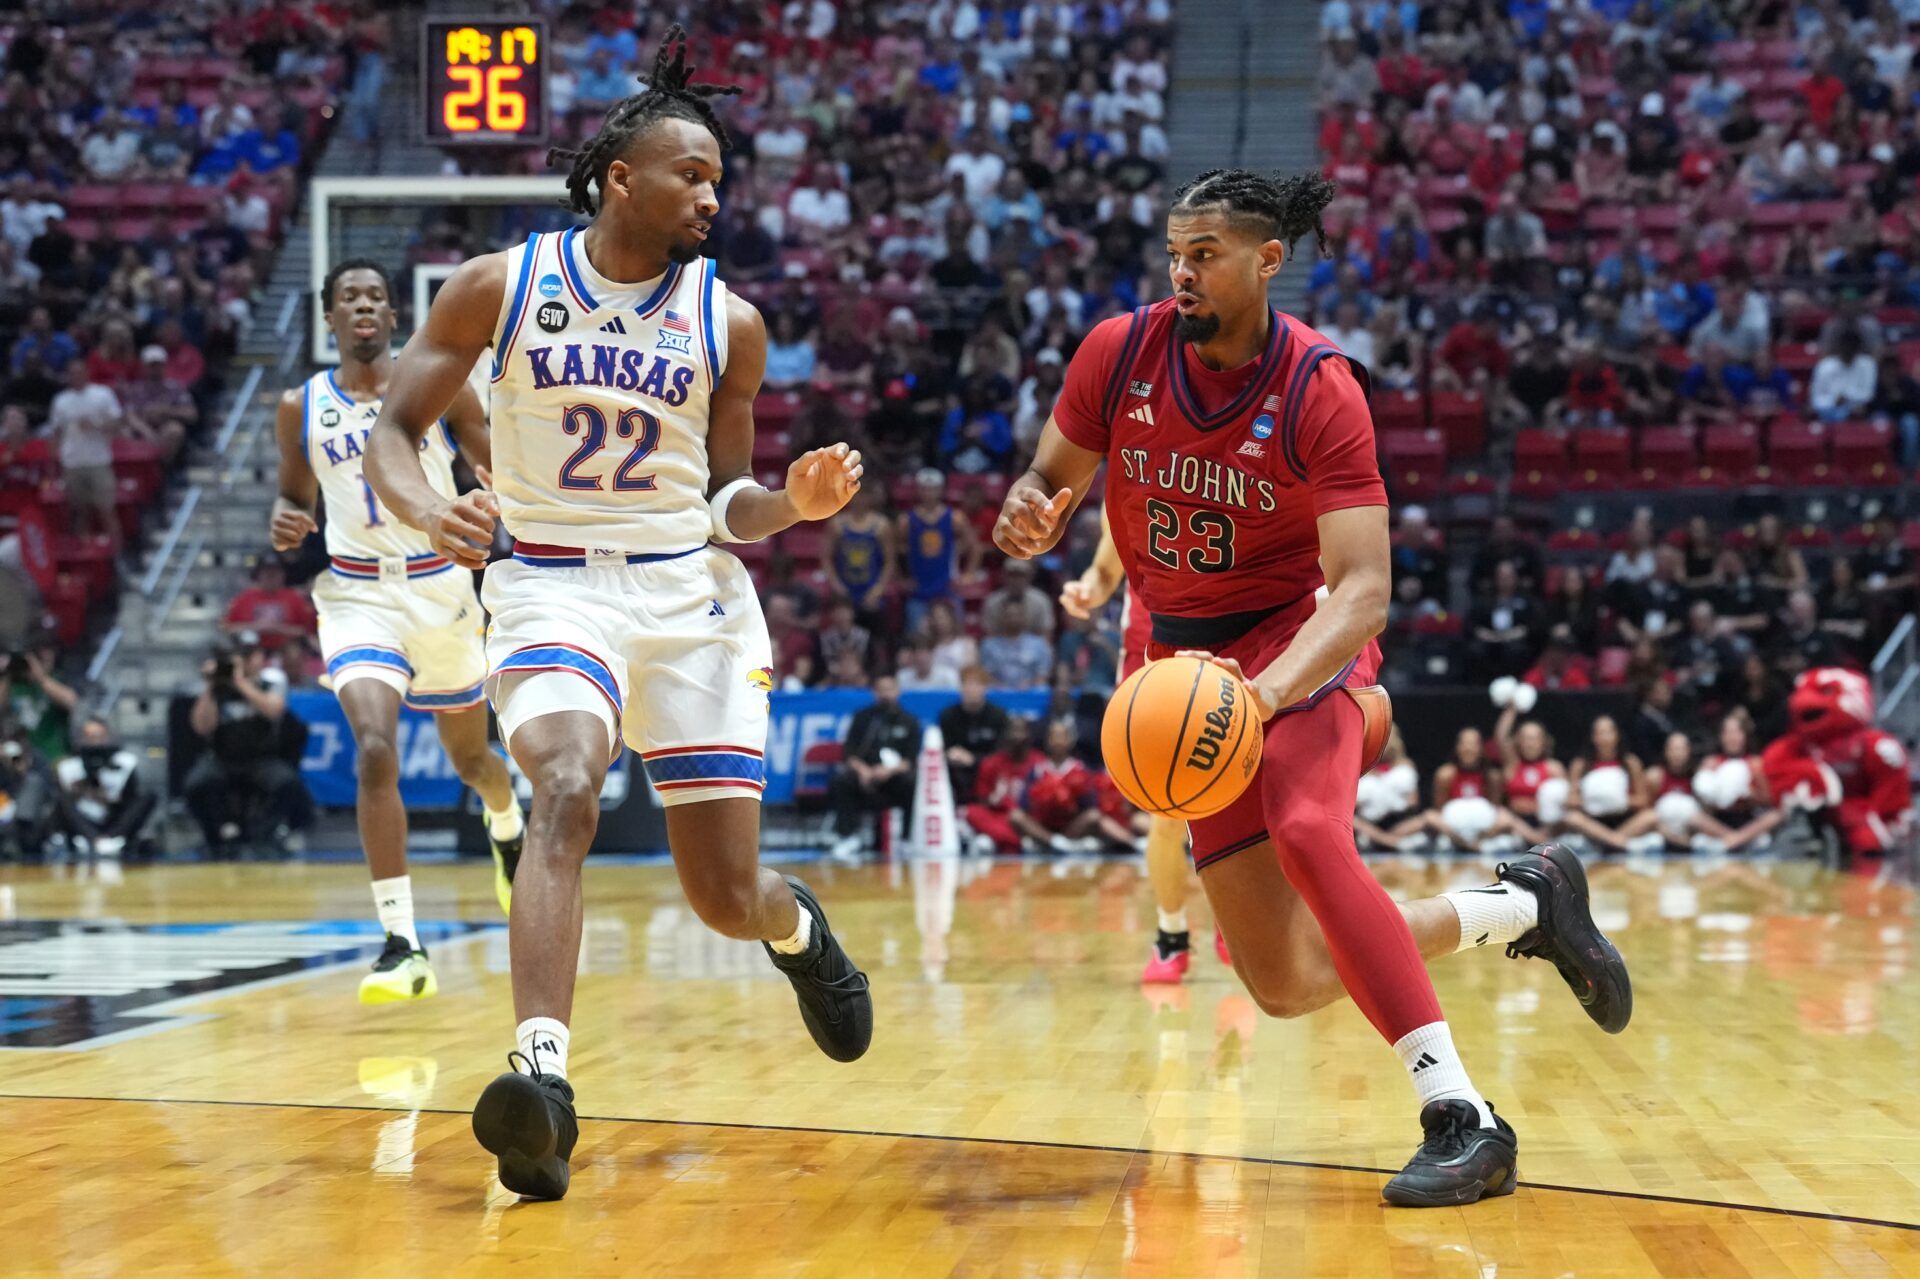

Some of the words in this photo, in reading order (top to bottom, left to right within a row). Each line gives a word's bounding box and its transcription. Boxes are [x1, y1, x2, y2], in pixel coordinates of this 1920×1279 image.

[444, 65, 526, 131] 26
[540, 307, 566, 327] SW
[526, 344, 695, 406] KANSAS
[558, 403, 661, 492] 22
[1243, 440, 1262, 450] BIG
[1254, 423, 1273, 435] NCAA
[1121, 448, 1151, 485] ST.
[1157, 452, 1276, 512] JOHN'S
[1146, 498, 1236, 574] 23
[1186, 677, 1235, 772] Wilson
